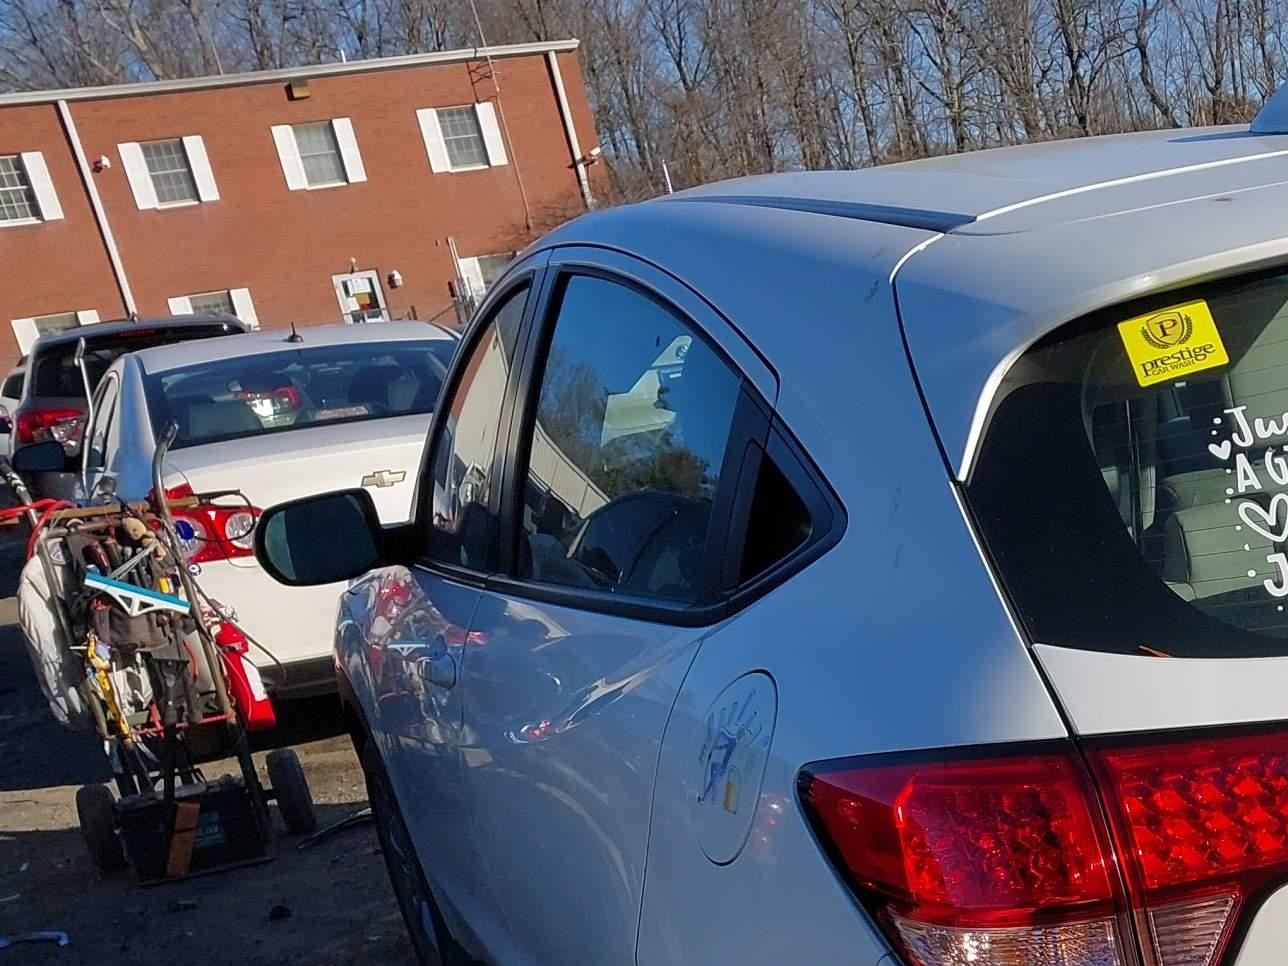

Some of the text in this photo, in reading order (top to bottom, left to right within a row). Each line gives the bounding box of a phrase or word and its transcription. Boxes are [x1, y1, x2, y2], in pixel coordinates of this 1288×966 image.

[1155, 319, 1177, 338] P
[1140, 343, 1216, 378] prestige
[1170, 359, 1195, 371] WASH
[1236, 453, 1263, 493] A
